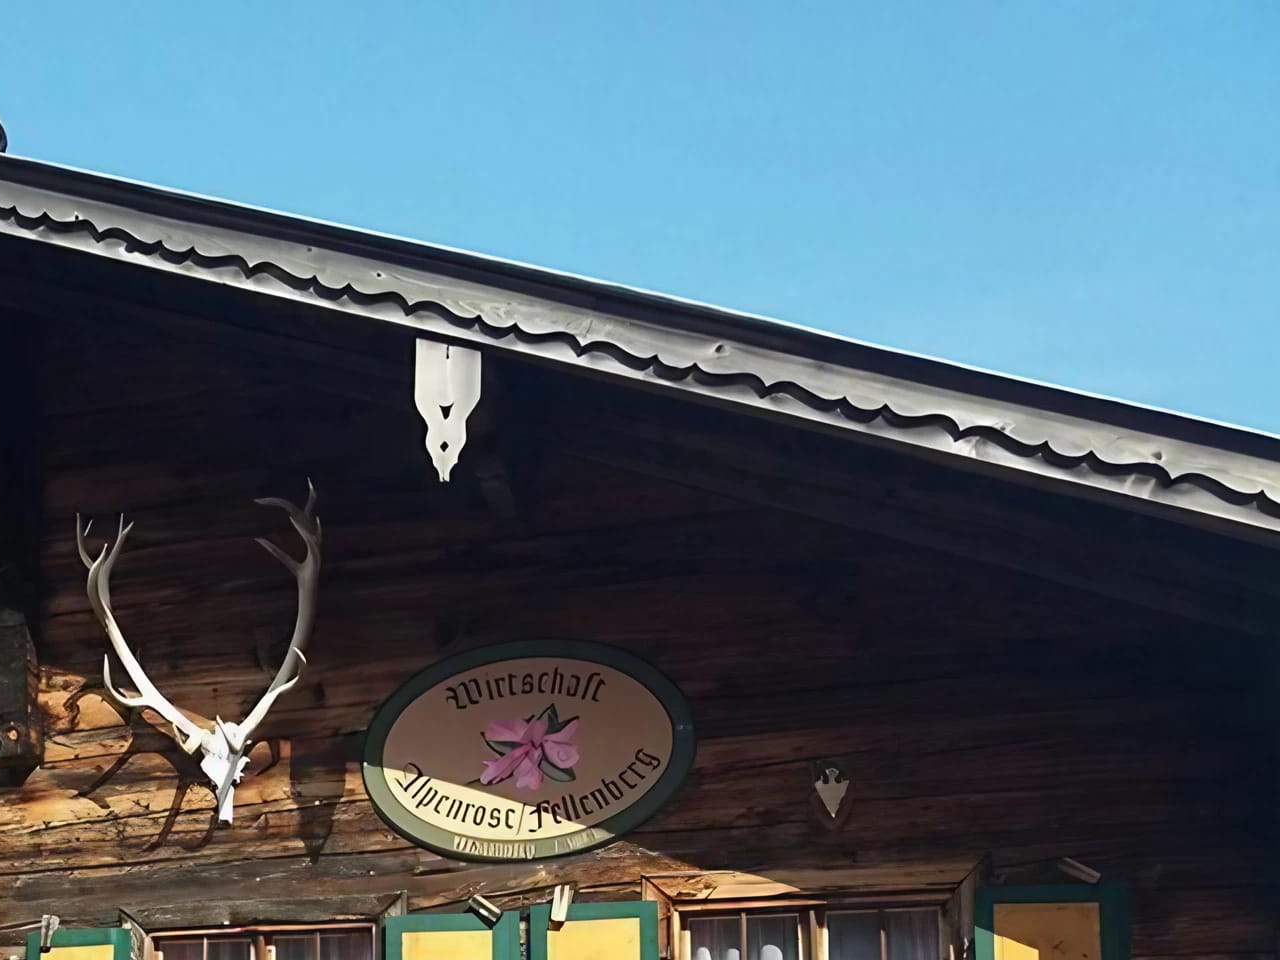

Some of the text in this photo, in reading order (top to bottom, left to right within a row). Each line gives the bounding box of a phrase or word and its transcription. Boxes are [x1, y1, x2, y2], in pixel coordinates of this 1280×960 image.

[446, 667, 607, 709] Wirtschaft
[395, 748, 661, 833] Alpenrose Fellenberg
